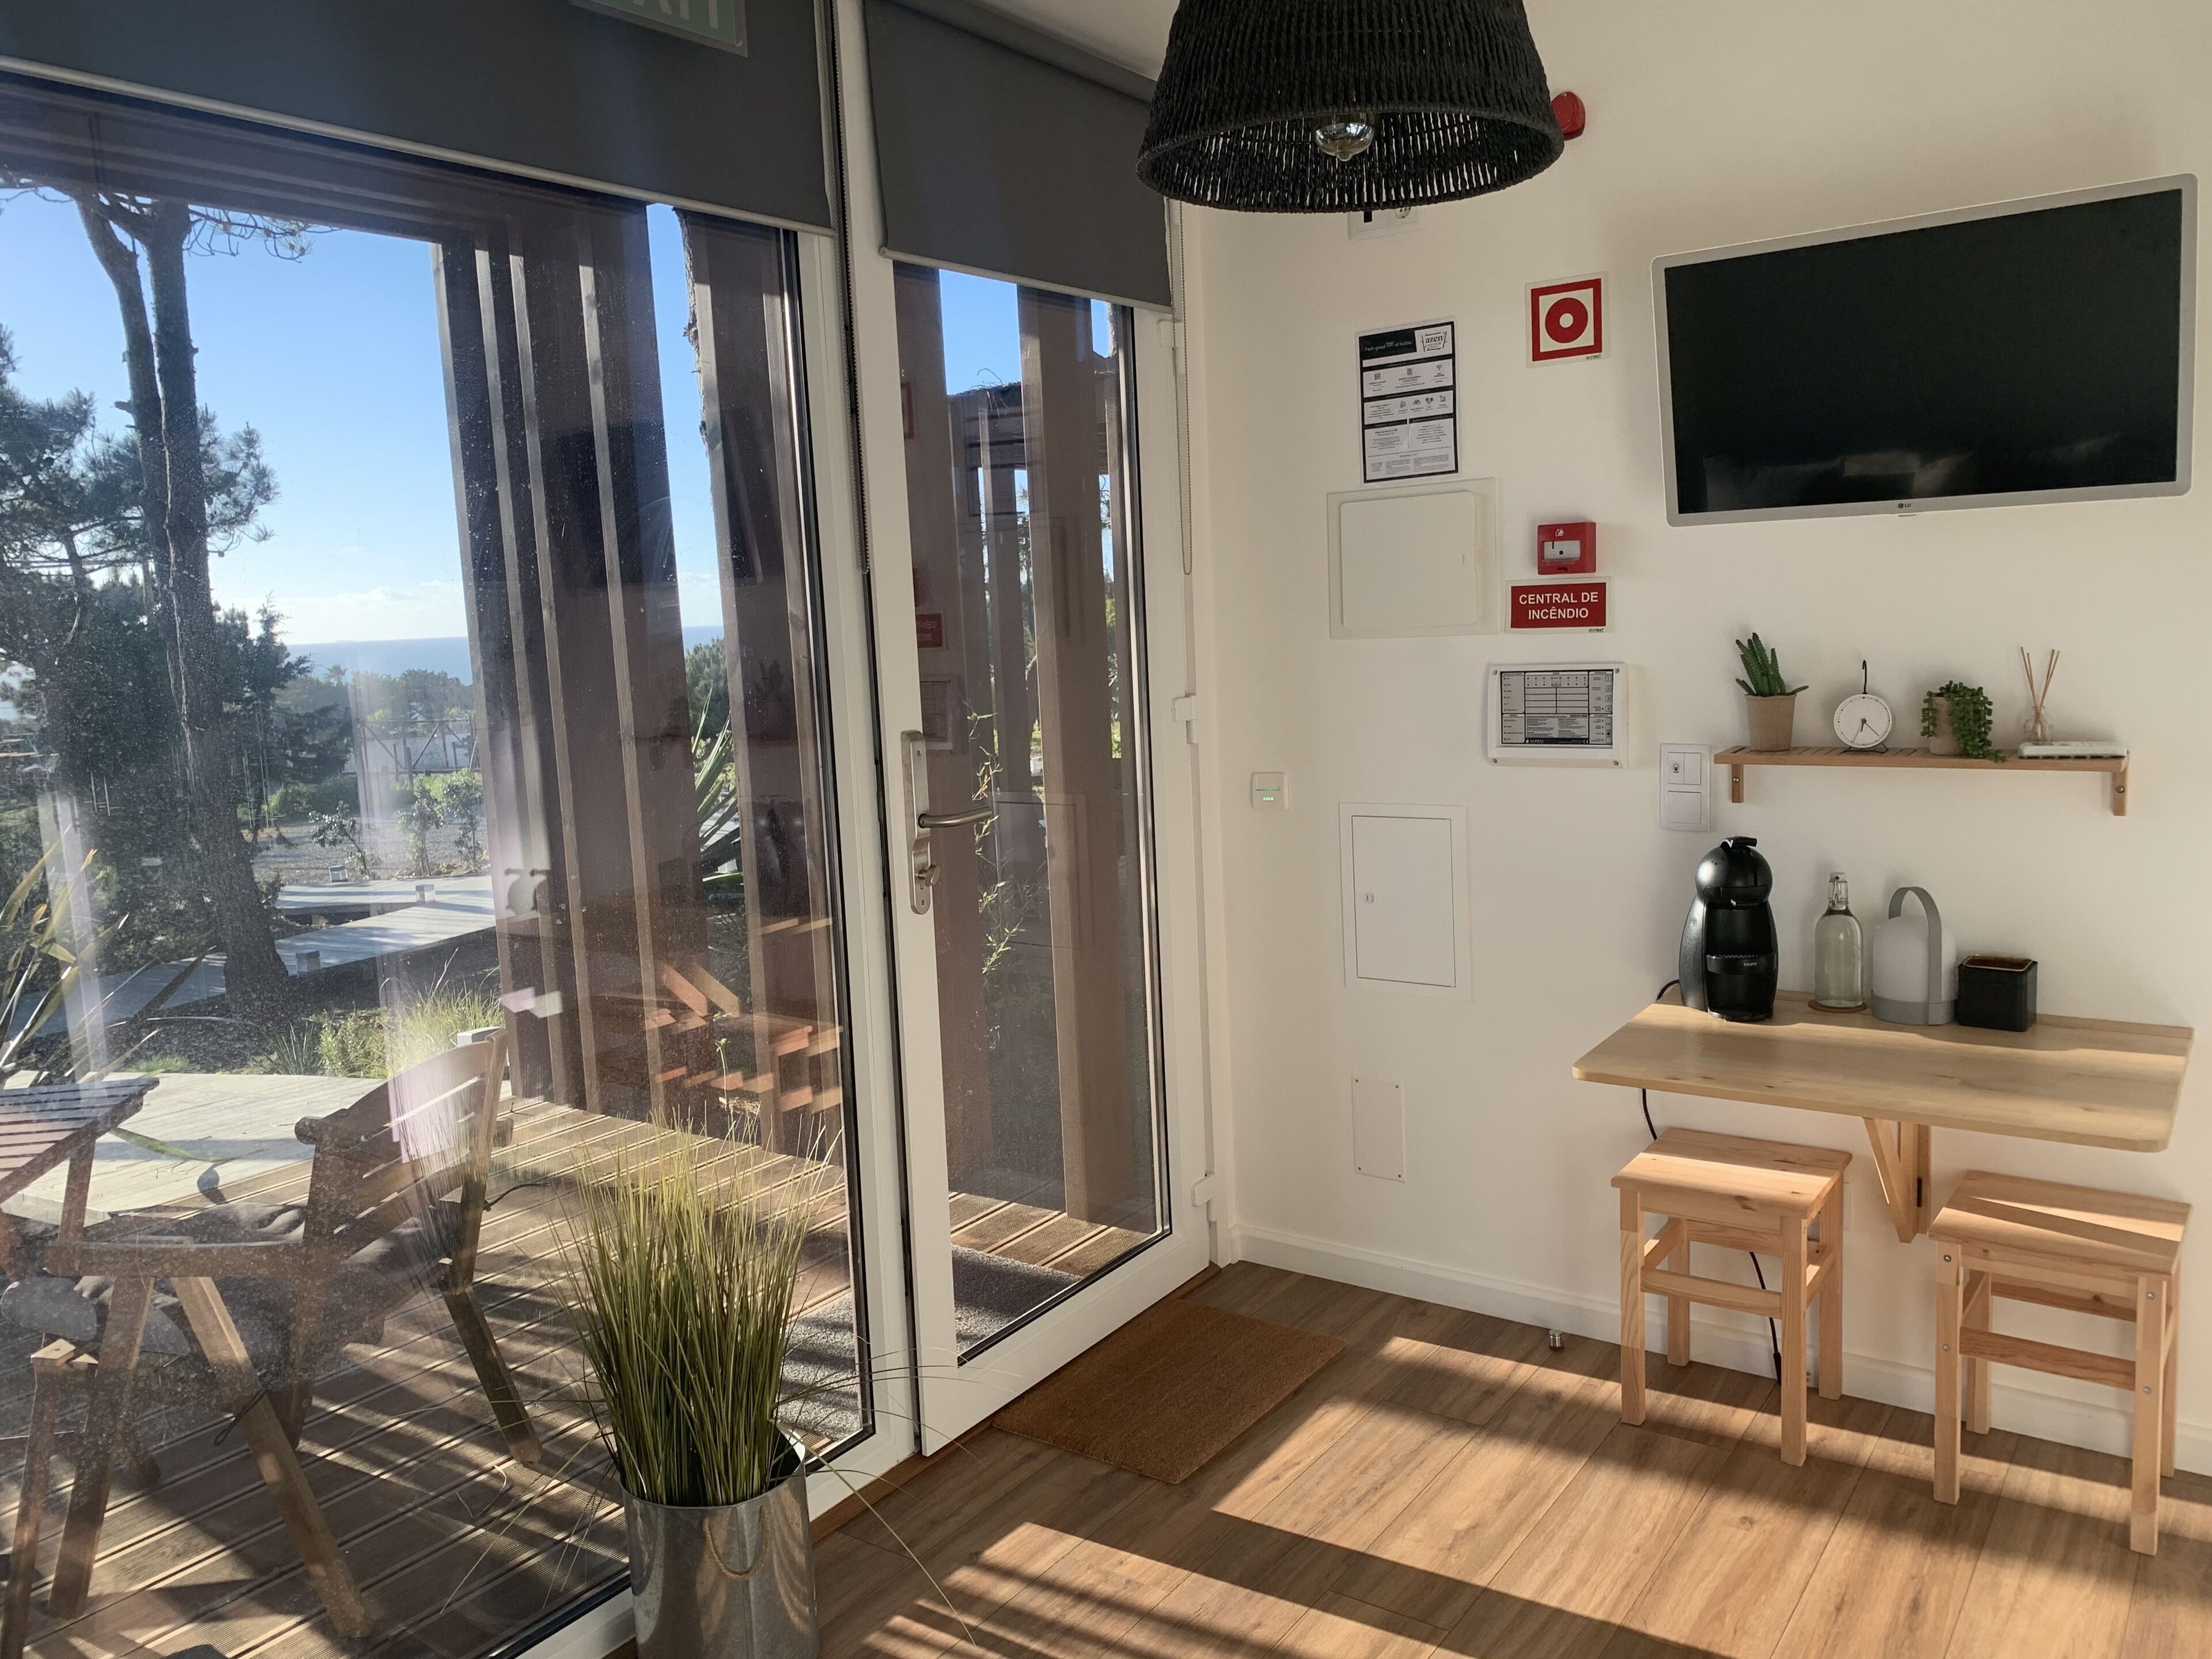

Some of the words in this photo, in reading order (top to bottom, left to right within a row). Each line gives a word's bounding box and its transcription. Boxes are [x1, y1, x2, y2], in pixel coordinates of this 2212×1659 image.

[1519, 593, 1577, 604] CENTRAL
[1581, 592, 1598, 603] DE
[1528, 606, 1589, 619] INCÊNDIO
